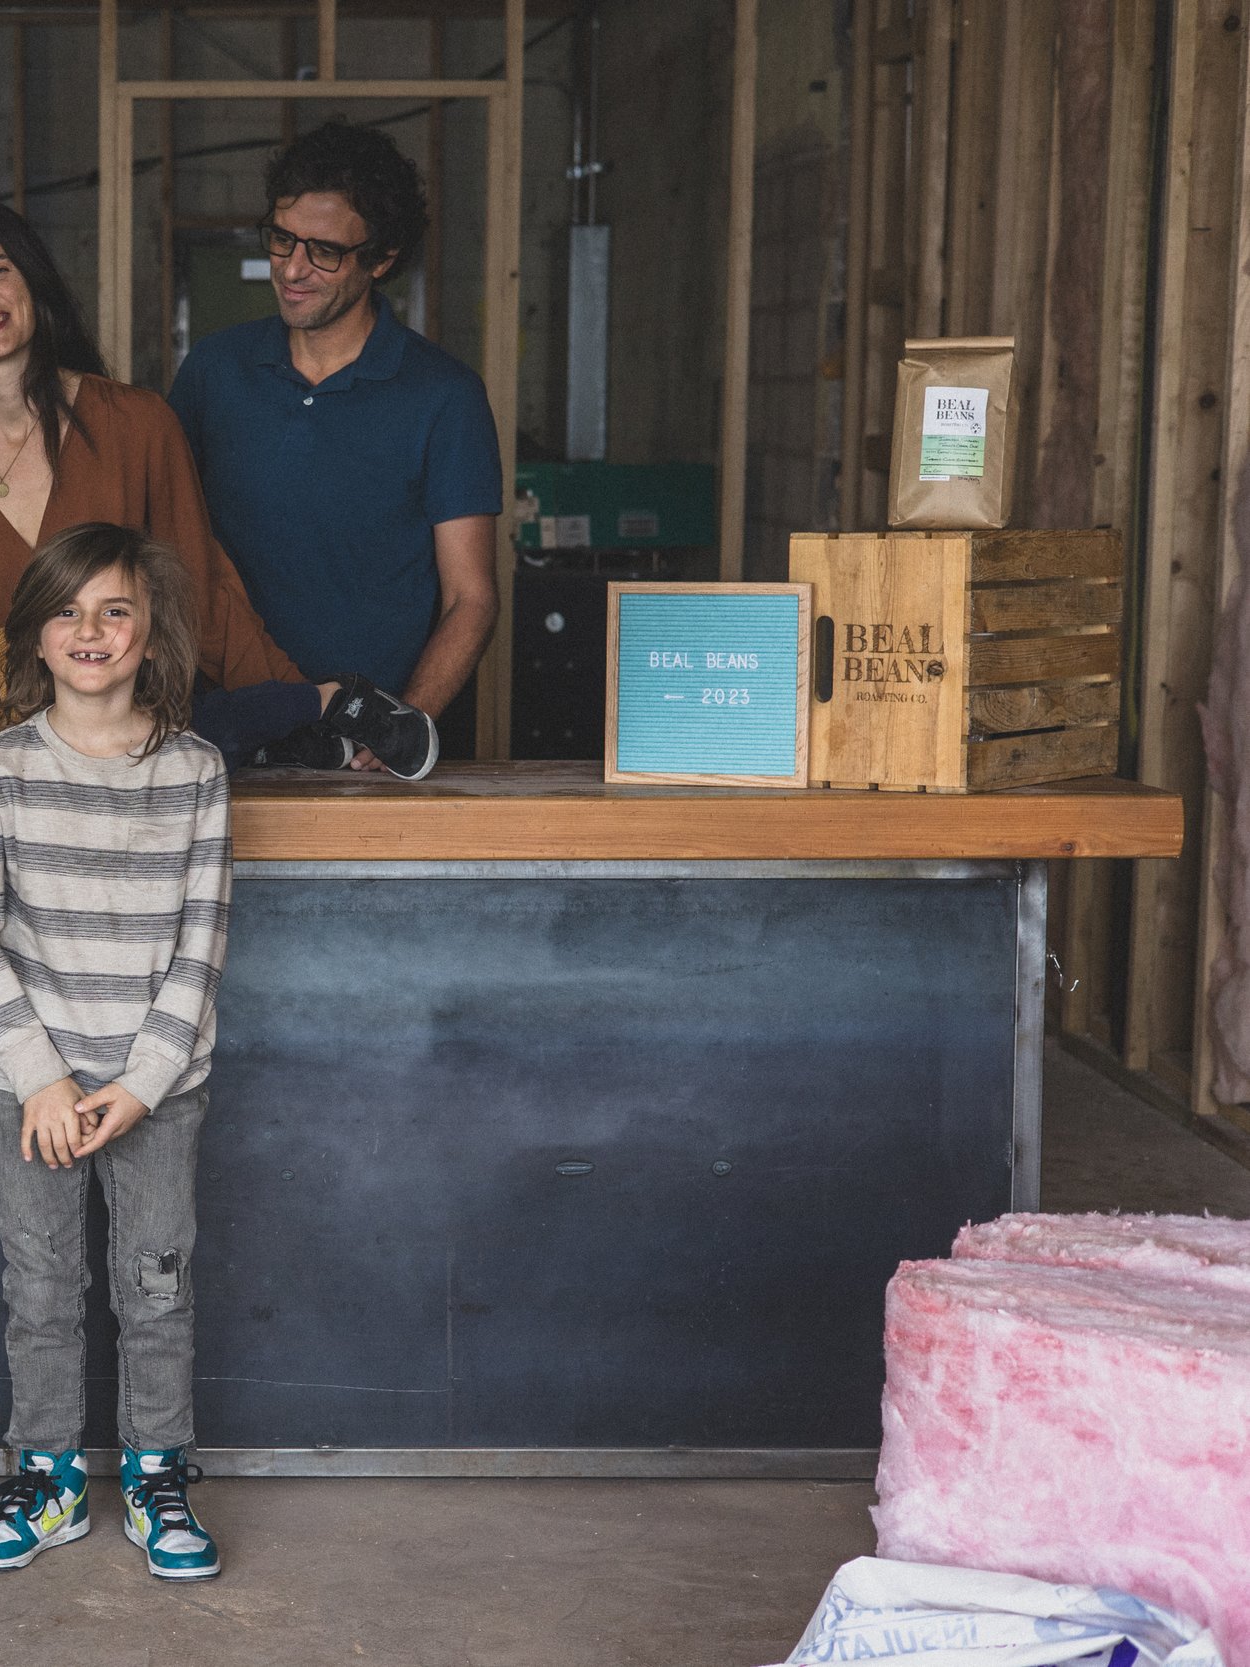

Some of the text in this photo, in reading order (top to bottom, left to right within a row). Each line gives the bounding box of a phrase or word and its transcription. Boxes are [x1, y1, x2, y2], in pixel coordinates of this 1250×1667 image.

[937, 399, 975, 411] BEAL
[936, 410, 975, 421] BEANS
[842, 623, 944, 654] BEAL
[650, 651, 759, 669] BEAL BEANS
[701, 688, 750, 705] 2023
